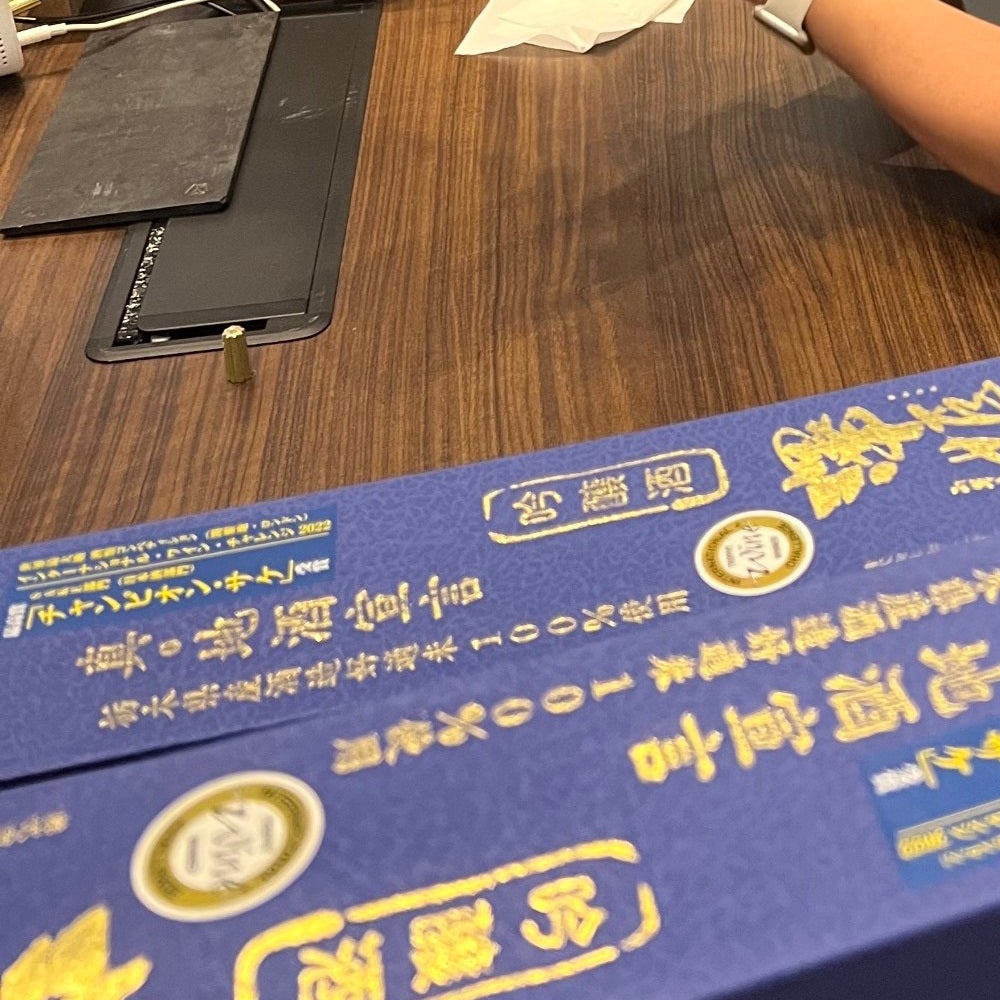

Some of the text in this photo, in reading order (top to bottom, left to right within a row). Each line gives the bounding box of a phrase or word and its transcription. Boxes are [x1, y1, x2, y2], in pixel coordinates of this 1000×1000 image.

[513, 460, 692, 526] 吟醸酒
[76, 573, 484, 679] 真・地酒宣言
